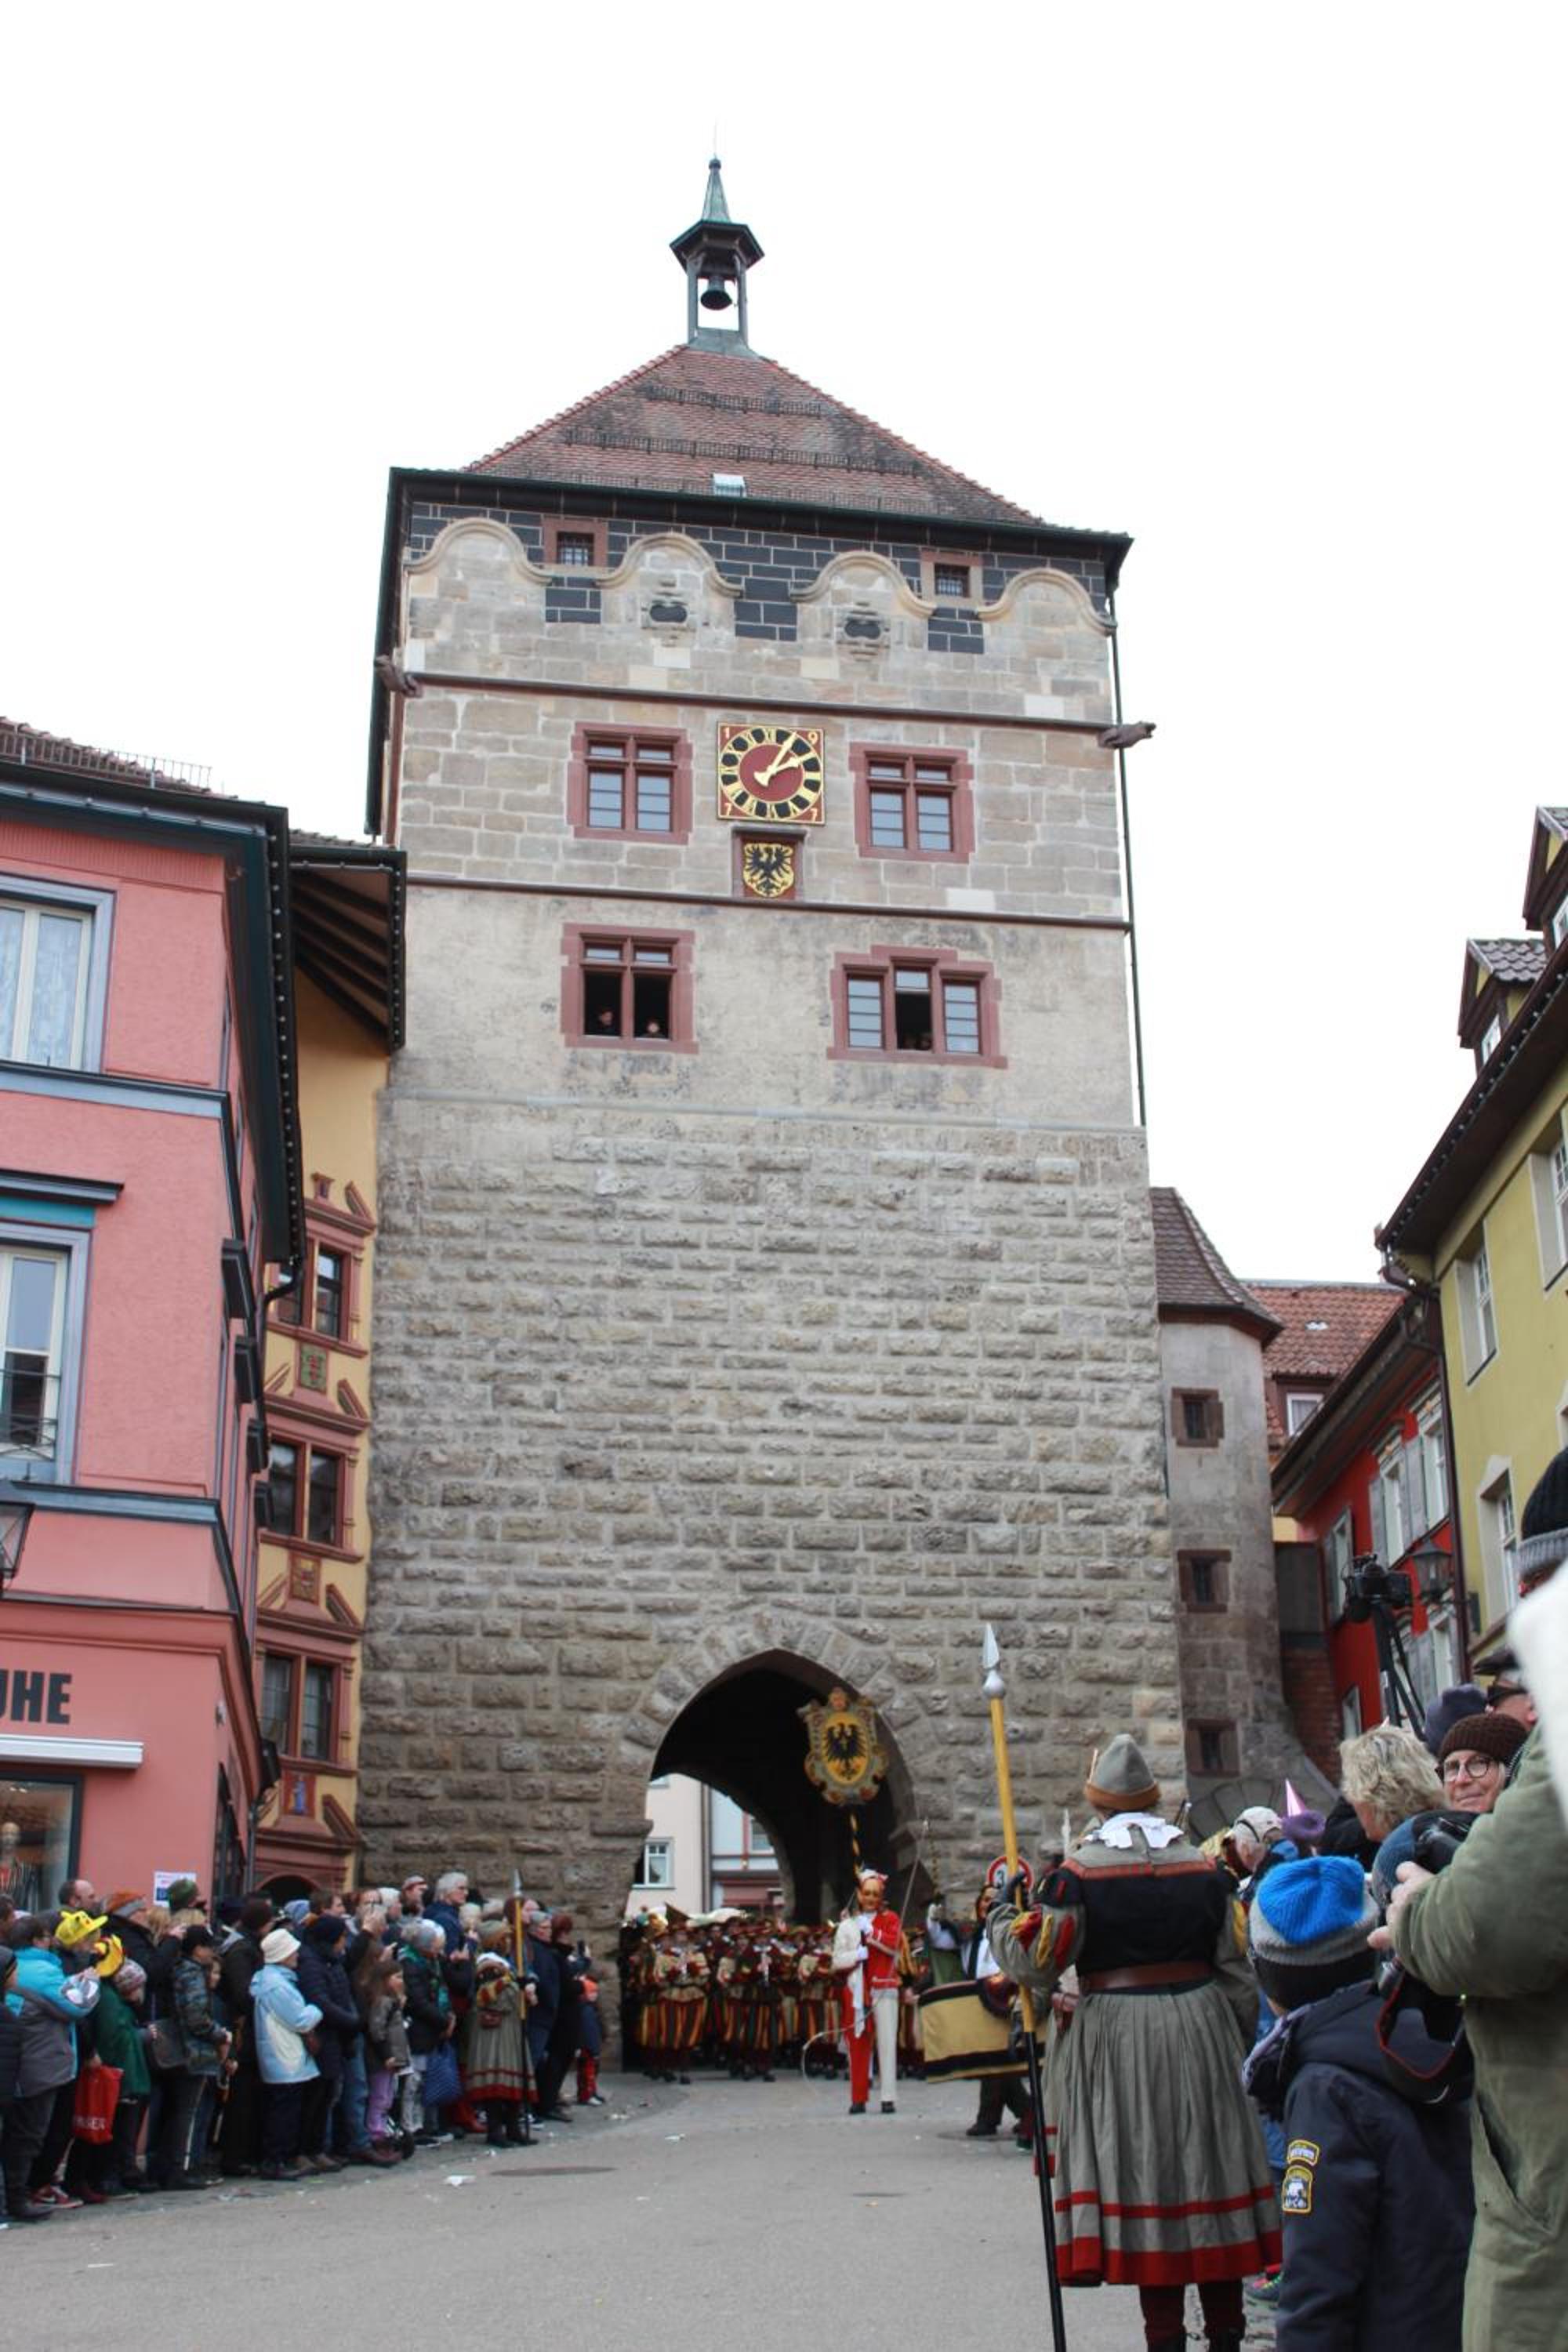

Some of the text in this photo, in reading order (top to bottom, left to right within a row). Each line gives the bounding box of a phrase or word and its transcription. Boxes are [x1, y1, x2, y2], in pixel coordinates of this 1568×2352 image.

[724, 727, 730, 739] 1
[808, 731, 818, 744] 9
[725, 803, 731, 815] 7
[811, 808, 818, 822] 7
[0, 1669, 71, 1724] HE
